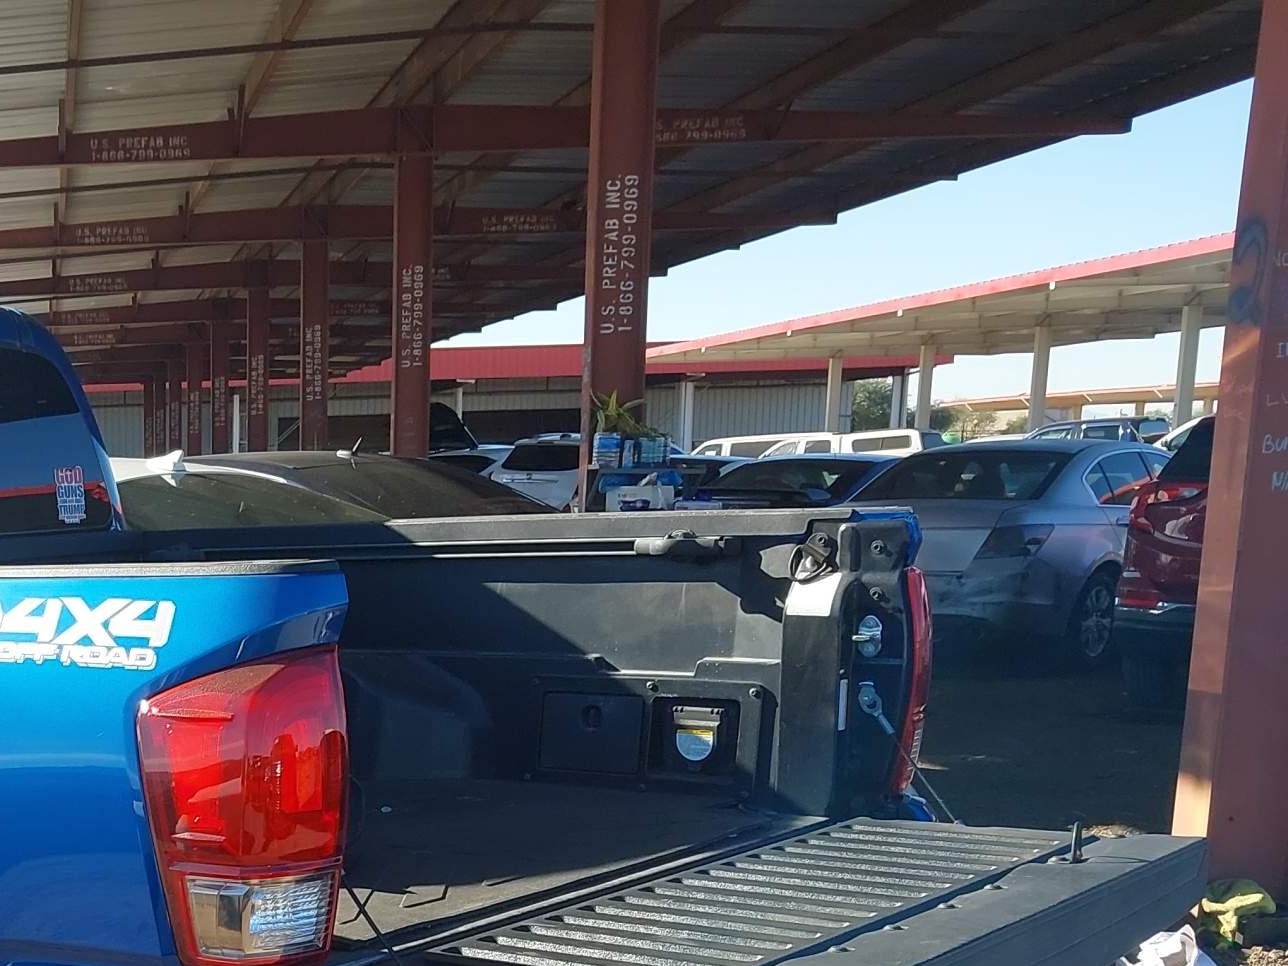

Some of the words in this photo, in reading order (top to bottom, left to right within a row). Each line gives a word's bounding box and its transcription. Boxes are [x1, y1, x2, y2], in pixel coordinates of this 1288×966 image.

[605, 174, 622, 209] INC.
[602, 218, 619, 289] PREFAB
[617, 174, 640, 331] 1-866-799-0969
[401, 293, 412, 339] PREFAB
[413, 265, 424, 366] 1-866-799-0969
[600, 299, 615, 334] U.S.
[400, 344, 412, 368] U.S.
[56, 484, 84, 499] GUNS
[60, 645, 158, 671] ROAD
